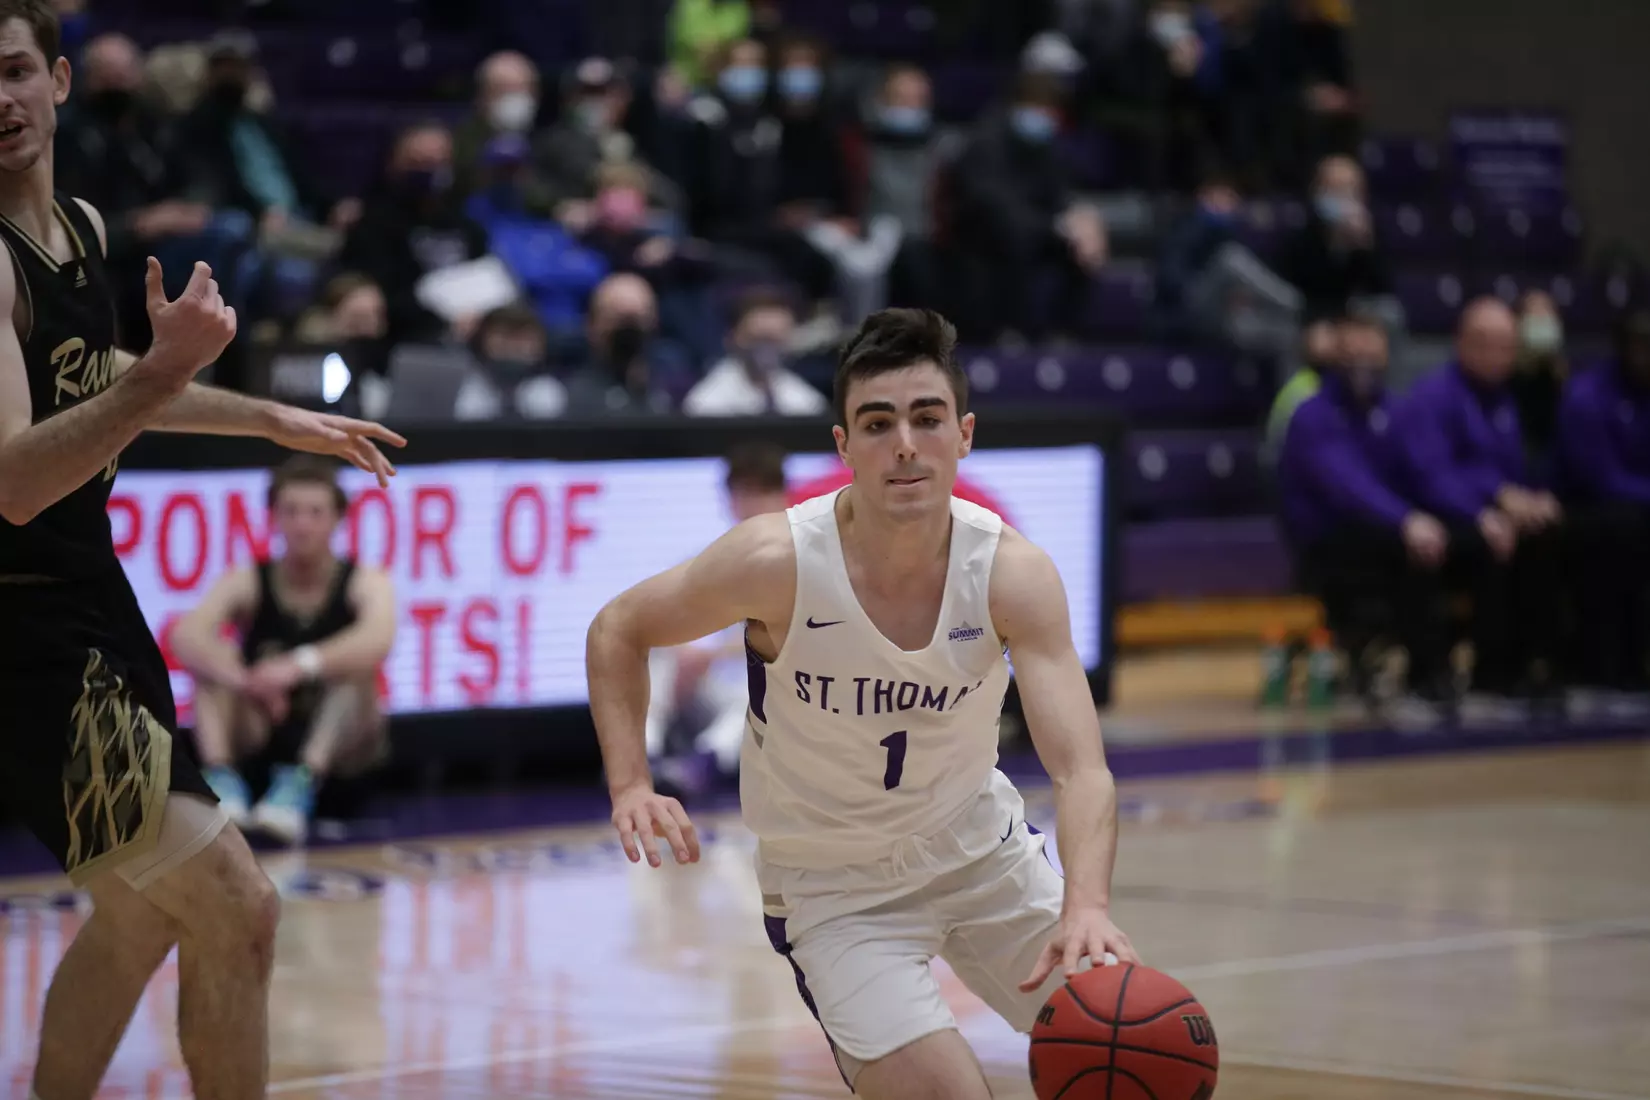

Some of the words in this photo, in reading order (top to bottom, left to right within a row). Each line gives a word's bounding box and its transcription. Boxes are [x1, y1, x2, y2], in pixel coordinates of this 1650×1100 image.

[500, 482, 602, 576] OF
[948, 628, 984, 640] SUMMIT
[795, 670, 839, 714] ST.
[880, 730, 907, 791] 1
